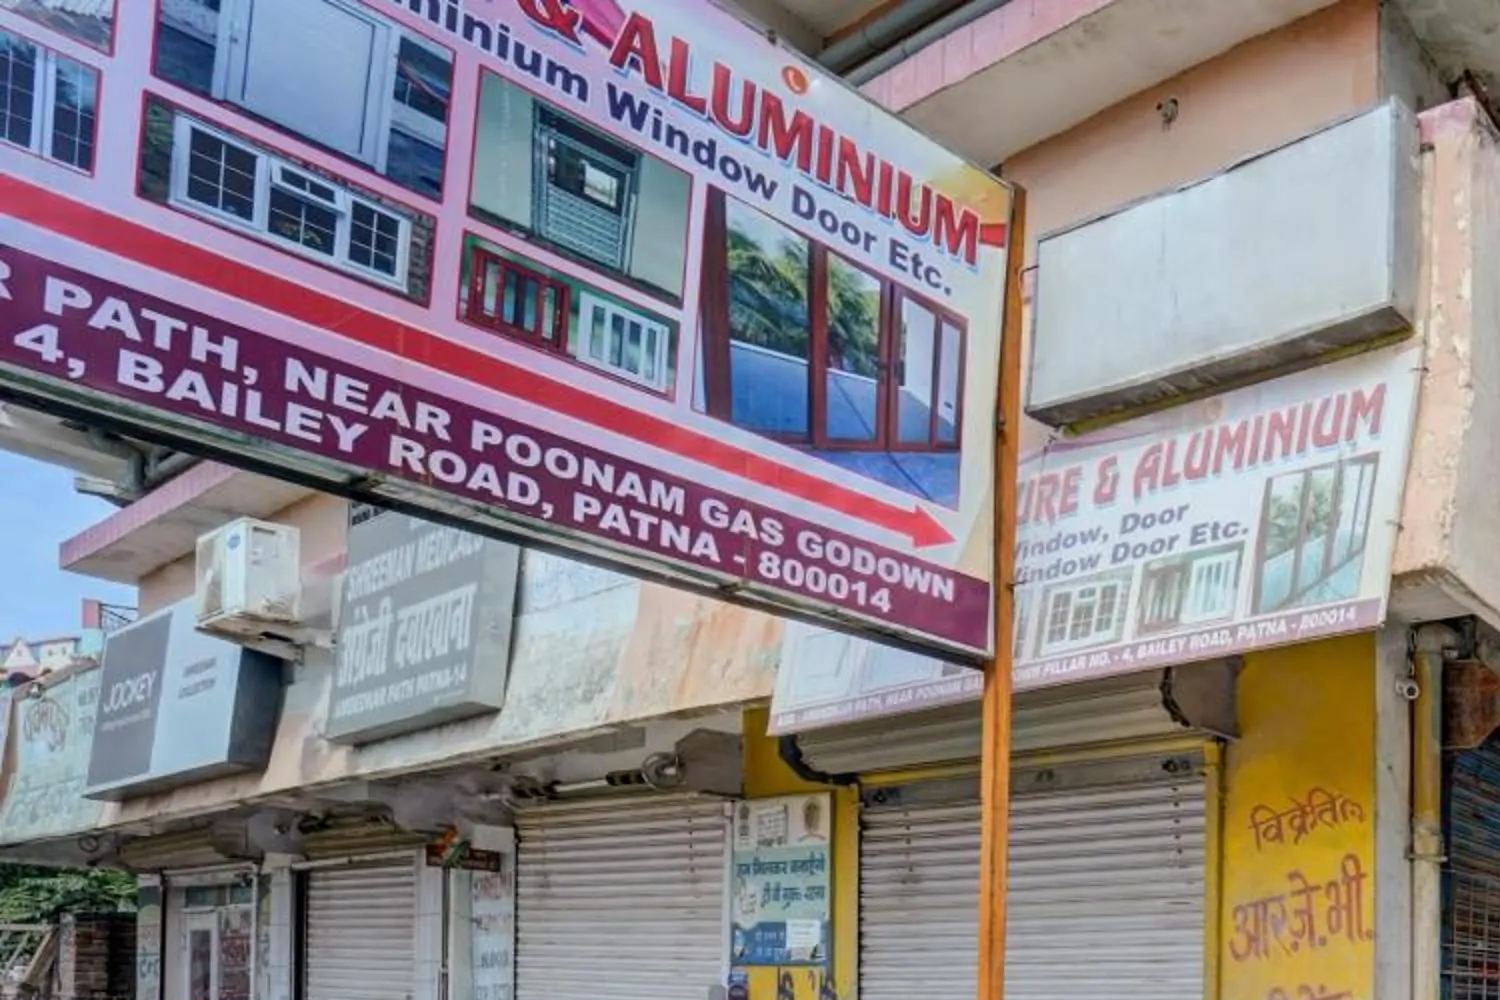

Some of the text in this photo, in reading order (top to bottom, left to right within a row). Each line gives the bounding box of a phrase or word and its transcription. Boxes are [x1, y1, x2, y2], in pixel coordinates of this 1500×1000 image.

[608, 83, 777, 200] Window
[791, 187, 878, 254] Door
[889, 243, 952, 296] Etc.
[609, 10, 983, 267] ALUMINIUM
[14, 323, 86, 379] 4,
[117, 349, 369, 454] BAILEY
[389, 436, 552, 519] ROAD,
[573, 494, 720, 563] PATNA
[759, 553, 891, 613] 800014
[43, 275, 258, 386] PATH,
[285, 357, 451, 441] NEAR
[471, 419, 686, 516] POONAM
[701, 498, 785, 547] GAS
[797, 532, 955, 602] GODOWN
[1093, 454, 1120, 506] &
[1134, 382, 1388, 498] ALUMINIUM
[1111, 533, 1180, 564] Door
[1190, 519, 1249, 546] Etc.
[1119, 504, 1191, 535] Door
